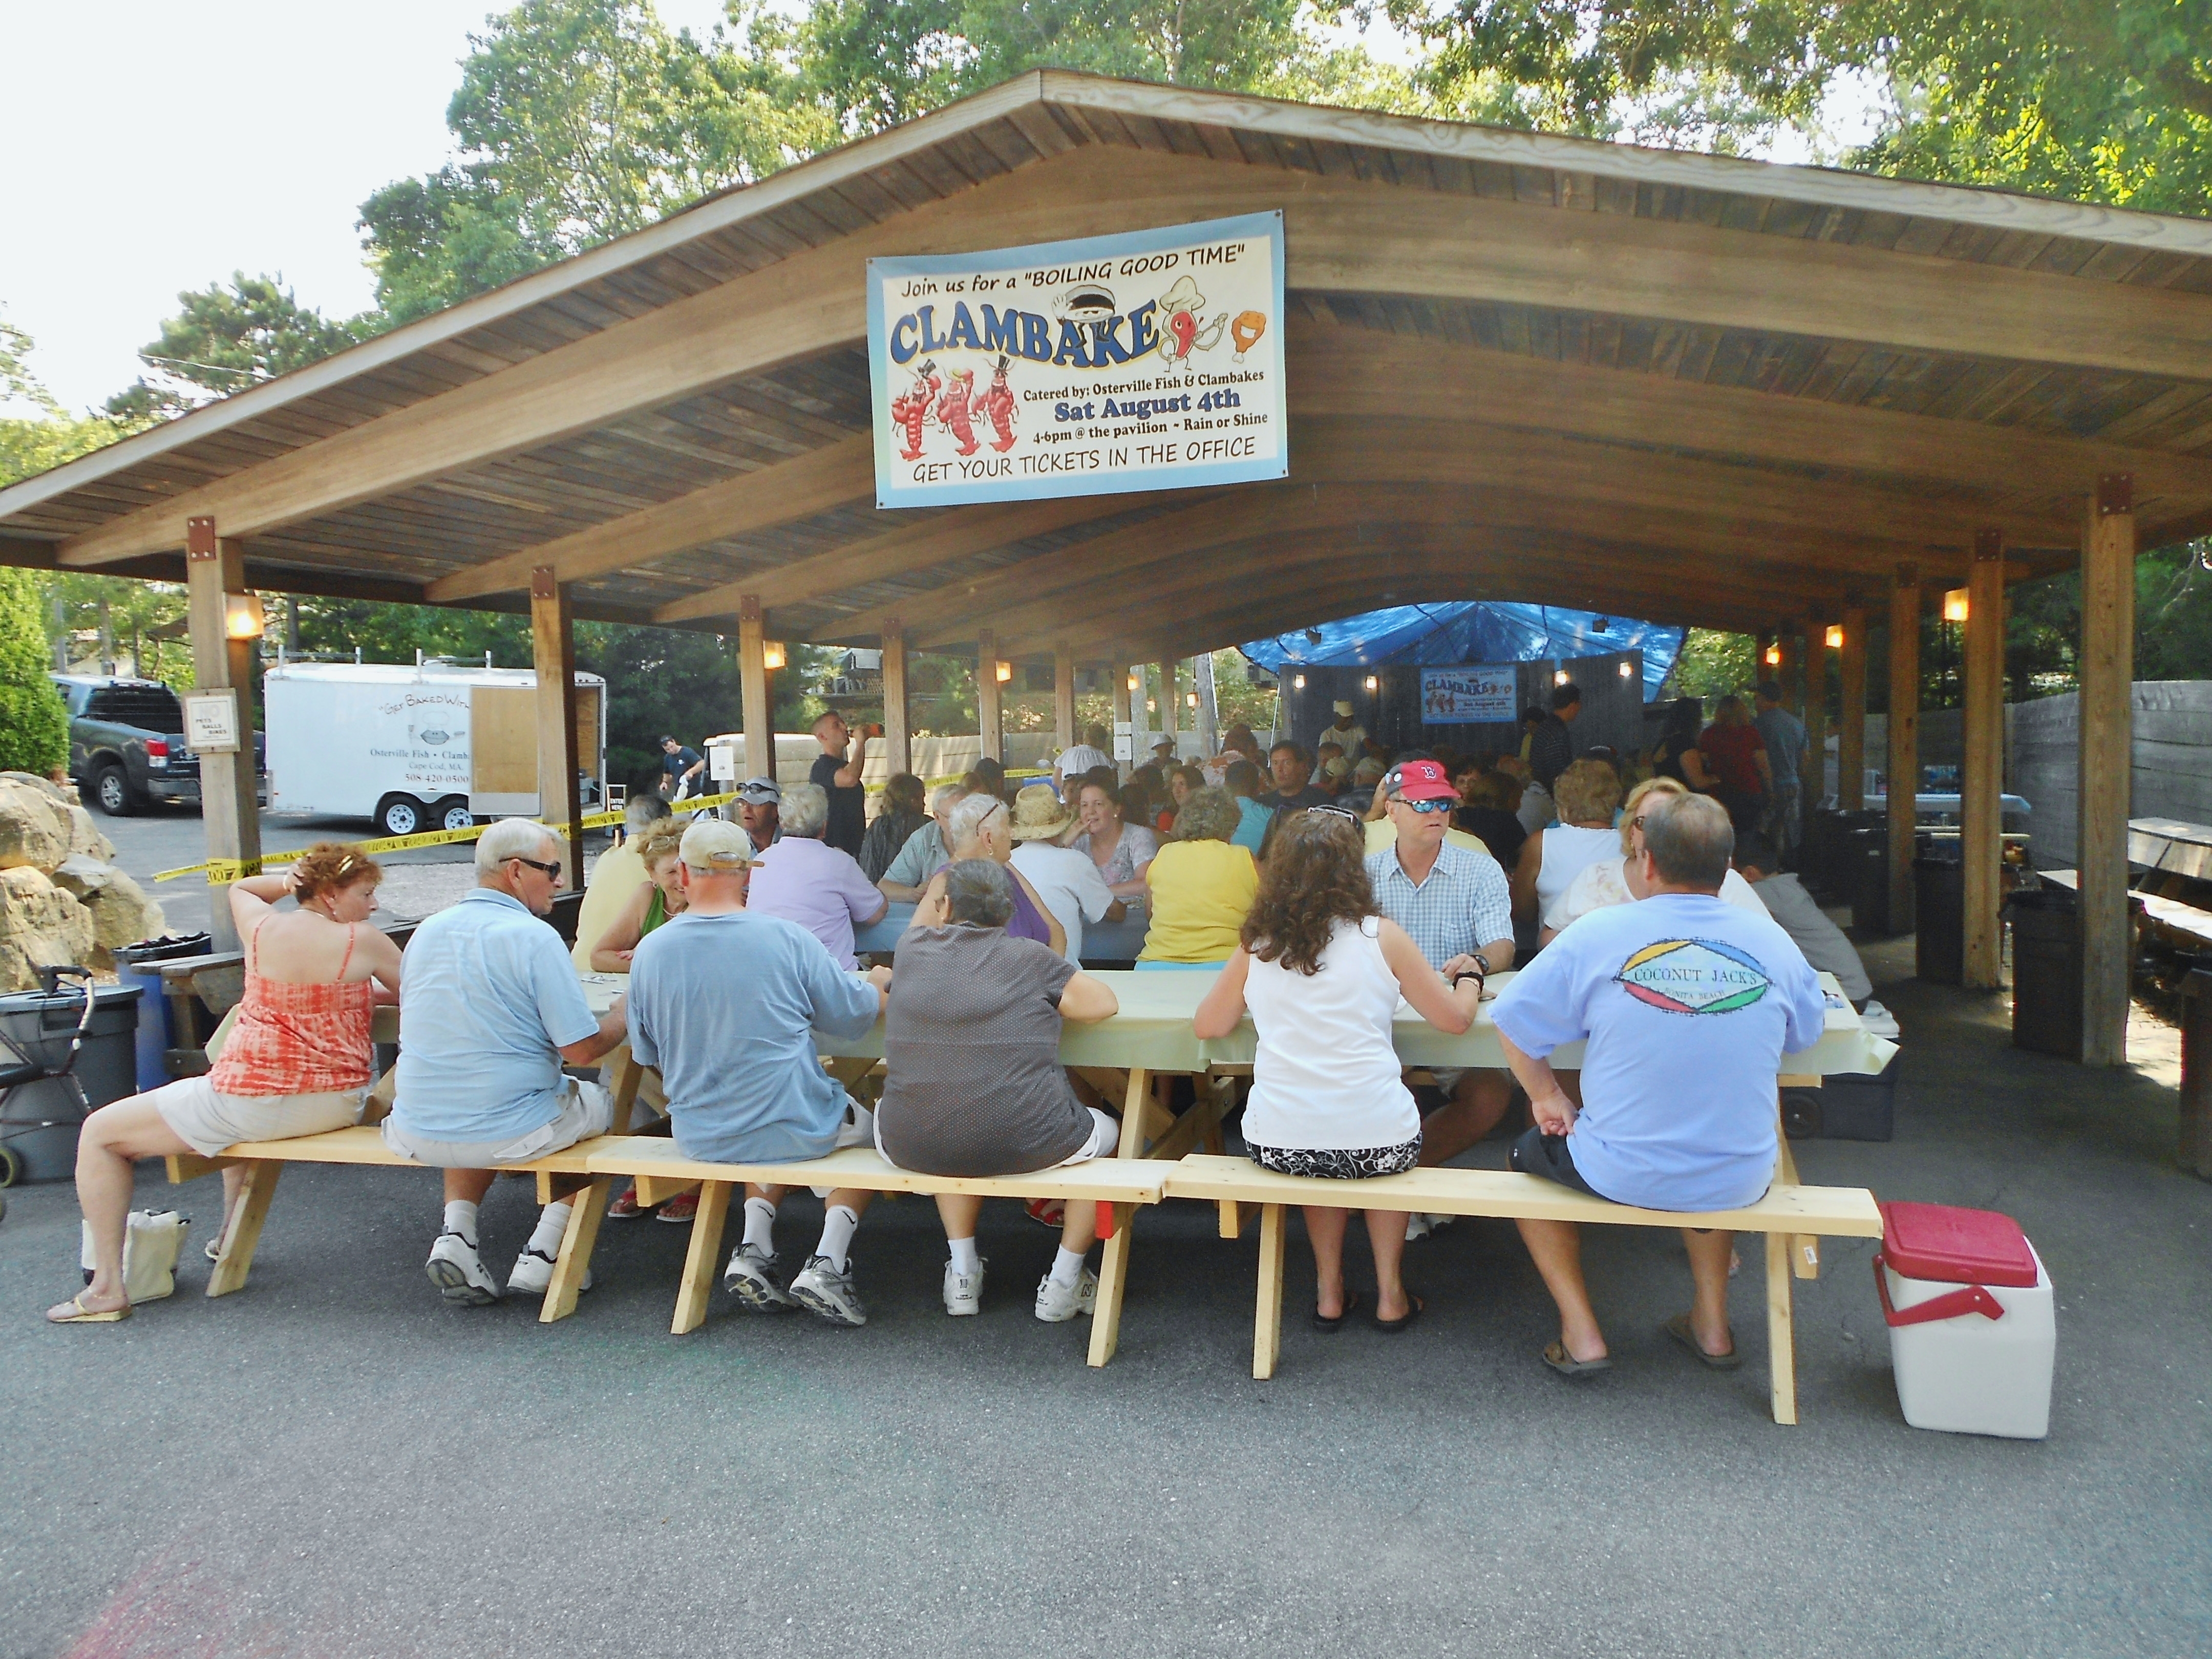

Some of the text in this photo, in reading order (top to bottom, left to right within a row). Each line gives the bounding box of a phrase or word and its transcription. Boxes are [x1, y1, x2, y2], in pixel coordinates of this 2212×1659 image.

[901, 244, 1245, 297] Join us for a "BOILING GOOD TIME"
[890, 299, 1159, 368] CLAMBAKE
[1024, 370, 1264, 401] Catered by: Osterville Fish & Clambakes
[1054, 388, 1241, 422] Sat August 4th
[1033, 431, 1072, 444] 4-6pm
[1075, 427, 1084, 439] @
[1088, 426, 1110, 438] the
[1113, 422, 1167, 438] pavilion
[1184, 417, 1213, 431] Rain
[1217, 419, 1230, 428] or
[1233, 413, 1268, 427] Shine
[913, 436, 1255, 483] GET YOUR TICKETS IN THE OFFICE
[370, 748, 469, 759] Osterville Fish Clamb
[409, 761, 427, 770] Cape
[1634, 968, 1757, 985] COCONUT JACK'S
[1699, 990, 1725, 999] BEACH
